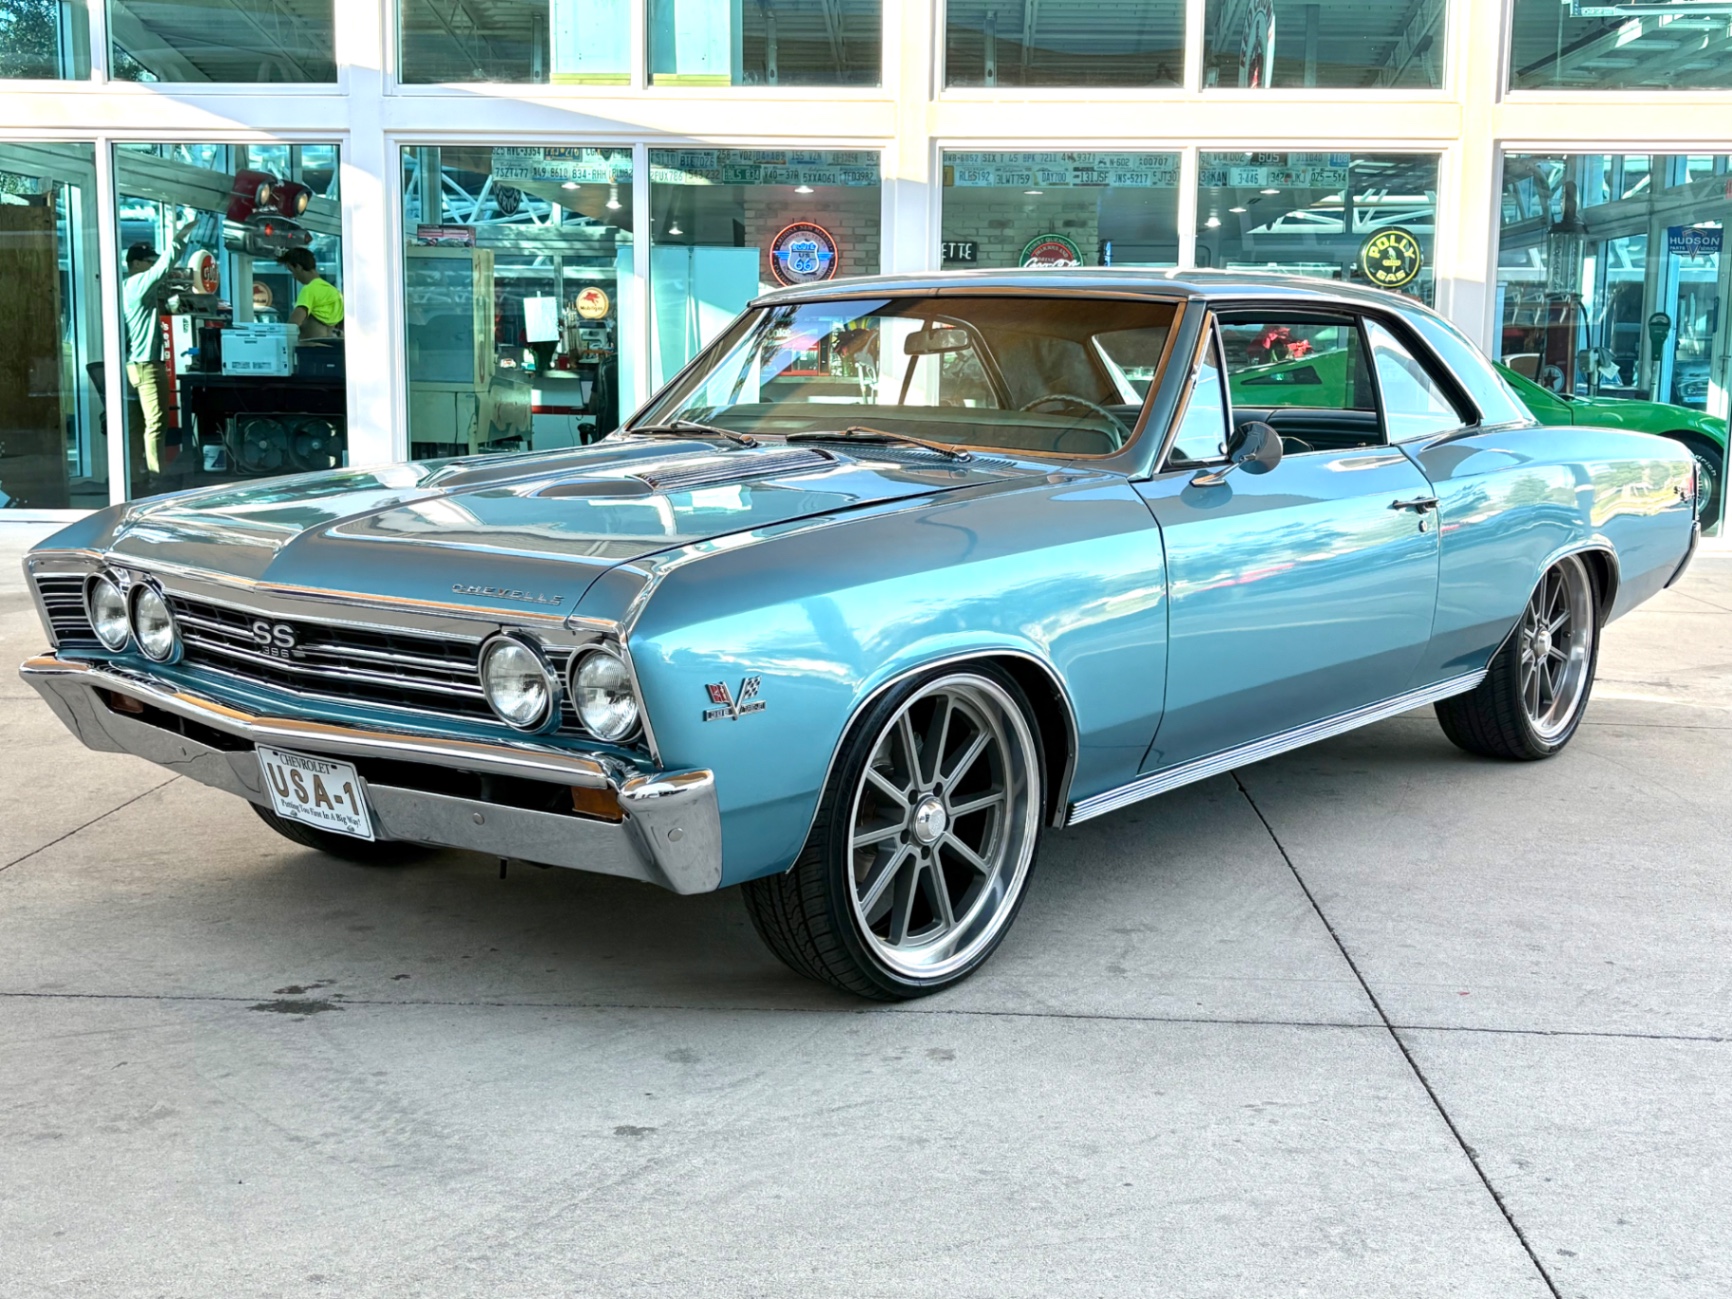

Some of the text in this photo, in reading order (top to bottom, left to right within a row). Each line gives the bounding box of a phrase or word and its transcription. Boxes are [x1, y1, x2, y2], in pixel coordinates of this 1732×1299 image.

[1368, 235, 1415, 259] POLLY
[1669, 236, 1720, 245] HUDSON
[794, 258, 812, 271] 66
[1376, 270, 1406, 283] GAS
[452, 583, 564, 605] CHEVELLE
[252, 621, 295, 648] SS
[280, 754, 331, 775] CHEVROLET
[267, 762, 360, 816] USA-1
